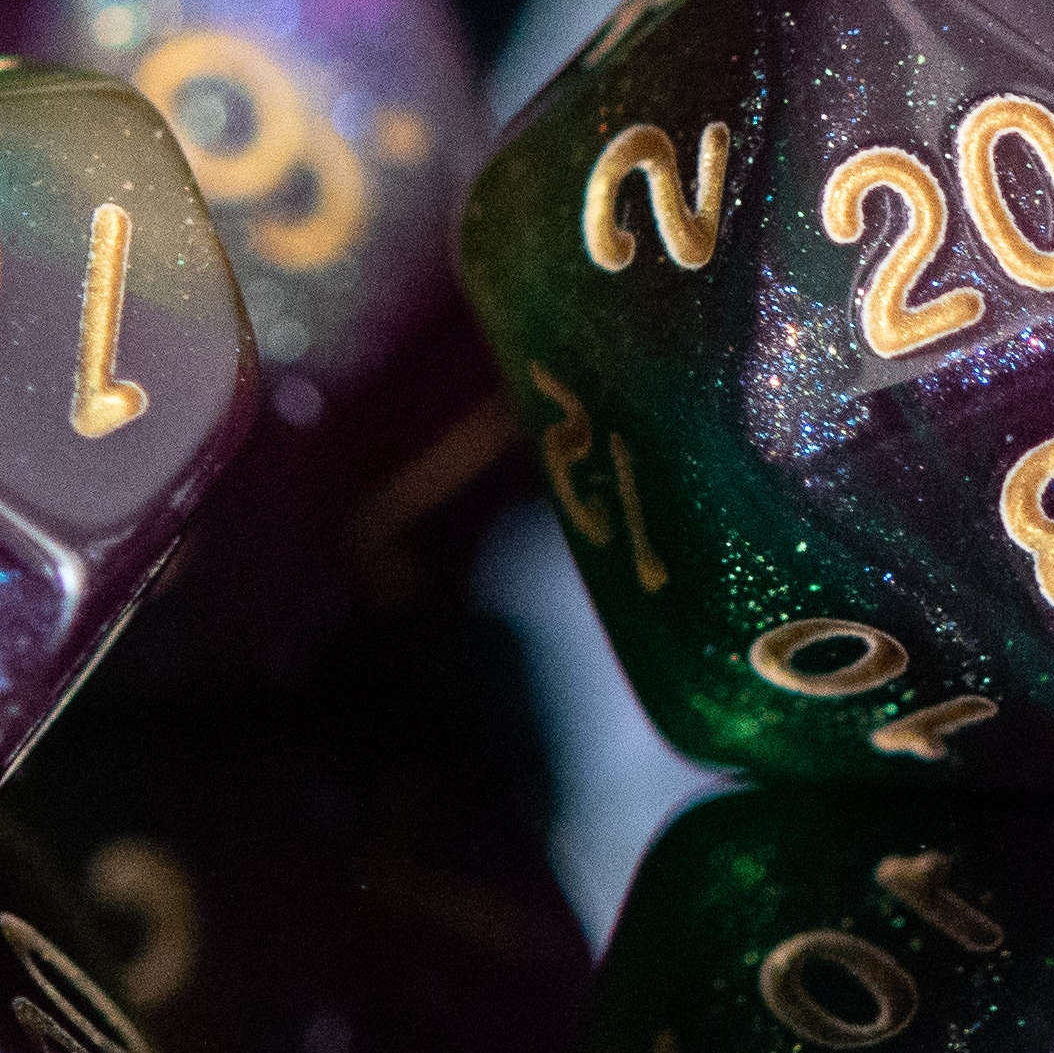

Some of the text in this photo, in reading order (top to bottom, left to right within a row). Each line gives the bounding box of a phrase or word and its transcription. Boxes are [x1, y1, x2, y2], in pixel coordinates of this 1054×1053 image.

[583, 120, 731, 272] 2
[70, 201, 149, 438] 1
[748, 617, 998, 760] 10
